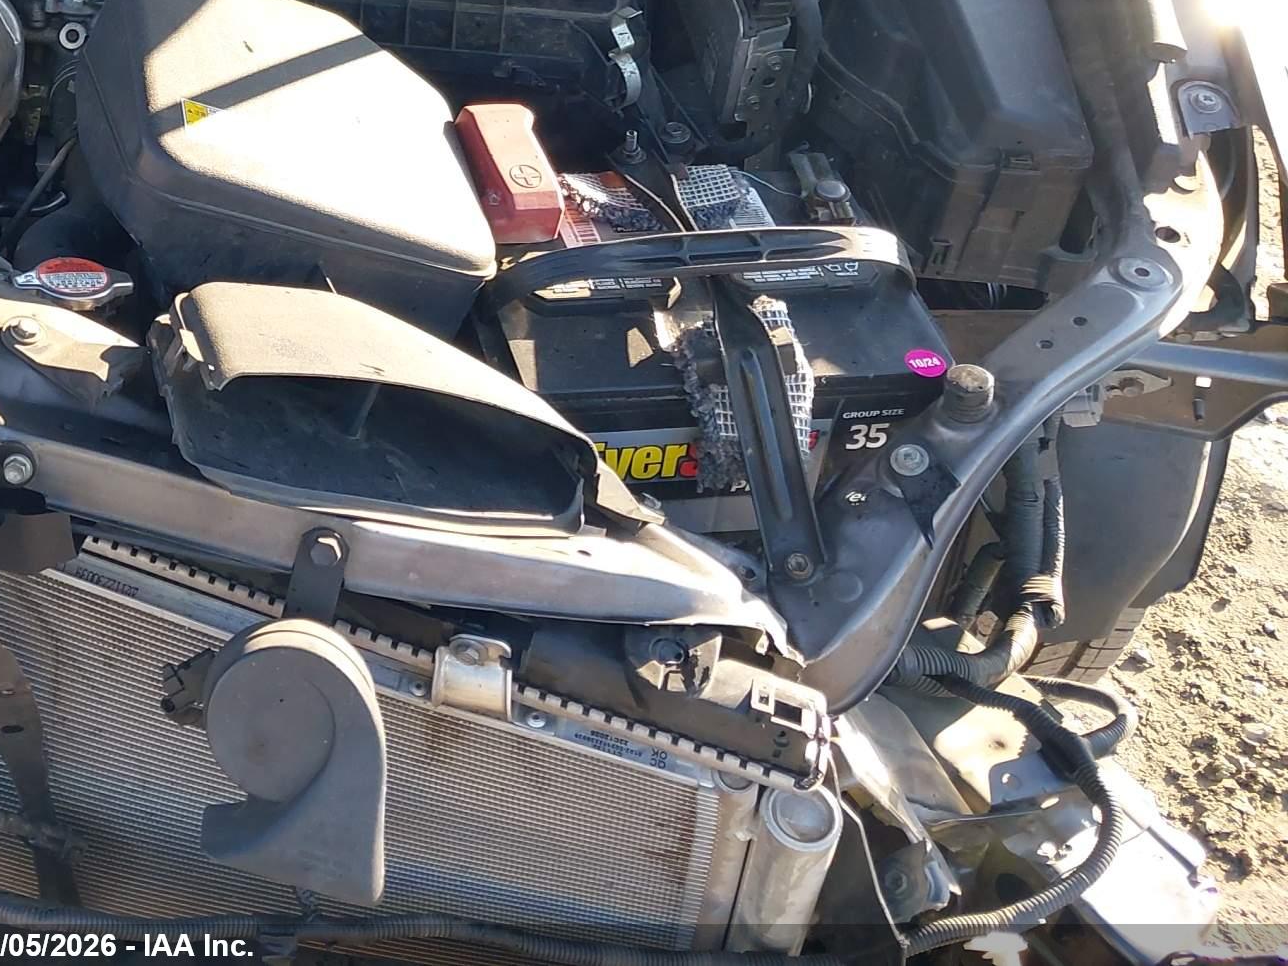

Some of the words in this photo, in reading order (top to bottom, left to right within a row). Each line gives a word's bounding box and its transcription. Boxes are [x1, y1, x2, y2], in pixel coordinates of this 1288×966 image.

[907, 356, 942, 369] 10/24
[842, 410, 880, 419] GROUP
[881, 408, 905, 416] SIZE
[845, 422, 890, 450] 35
